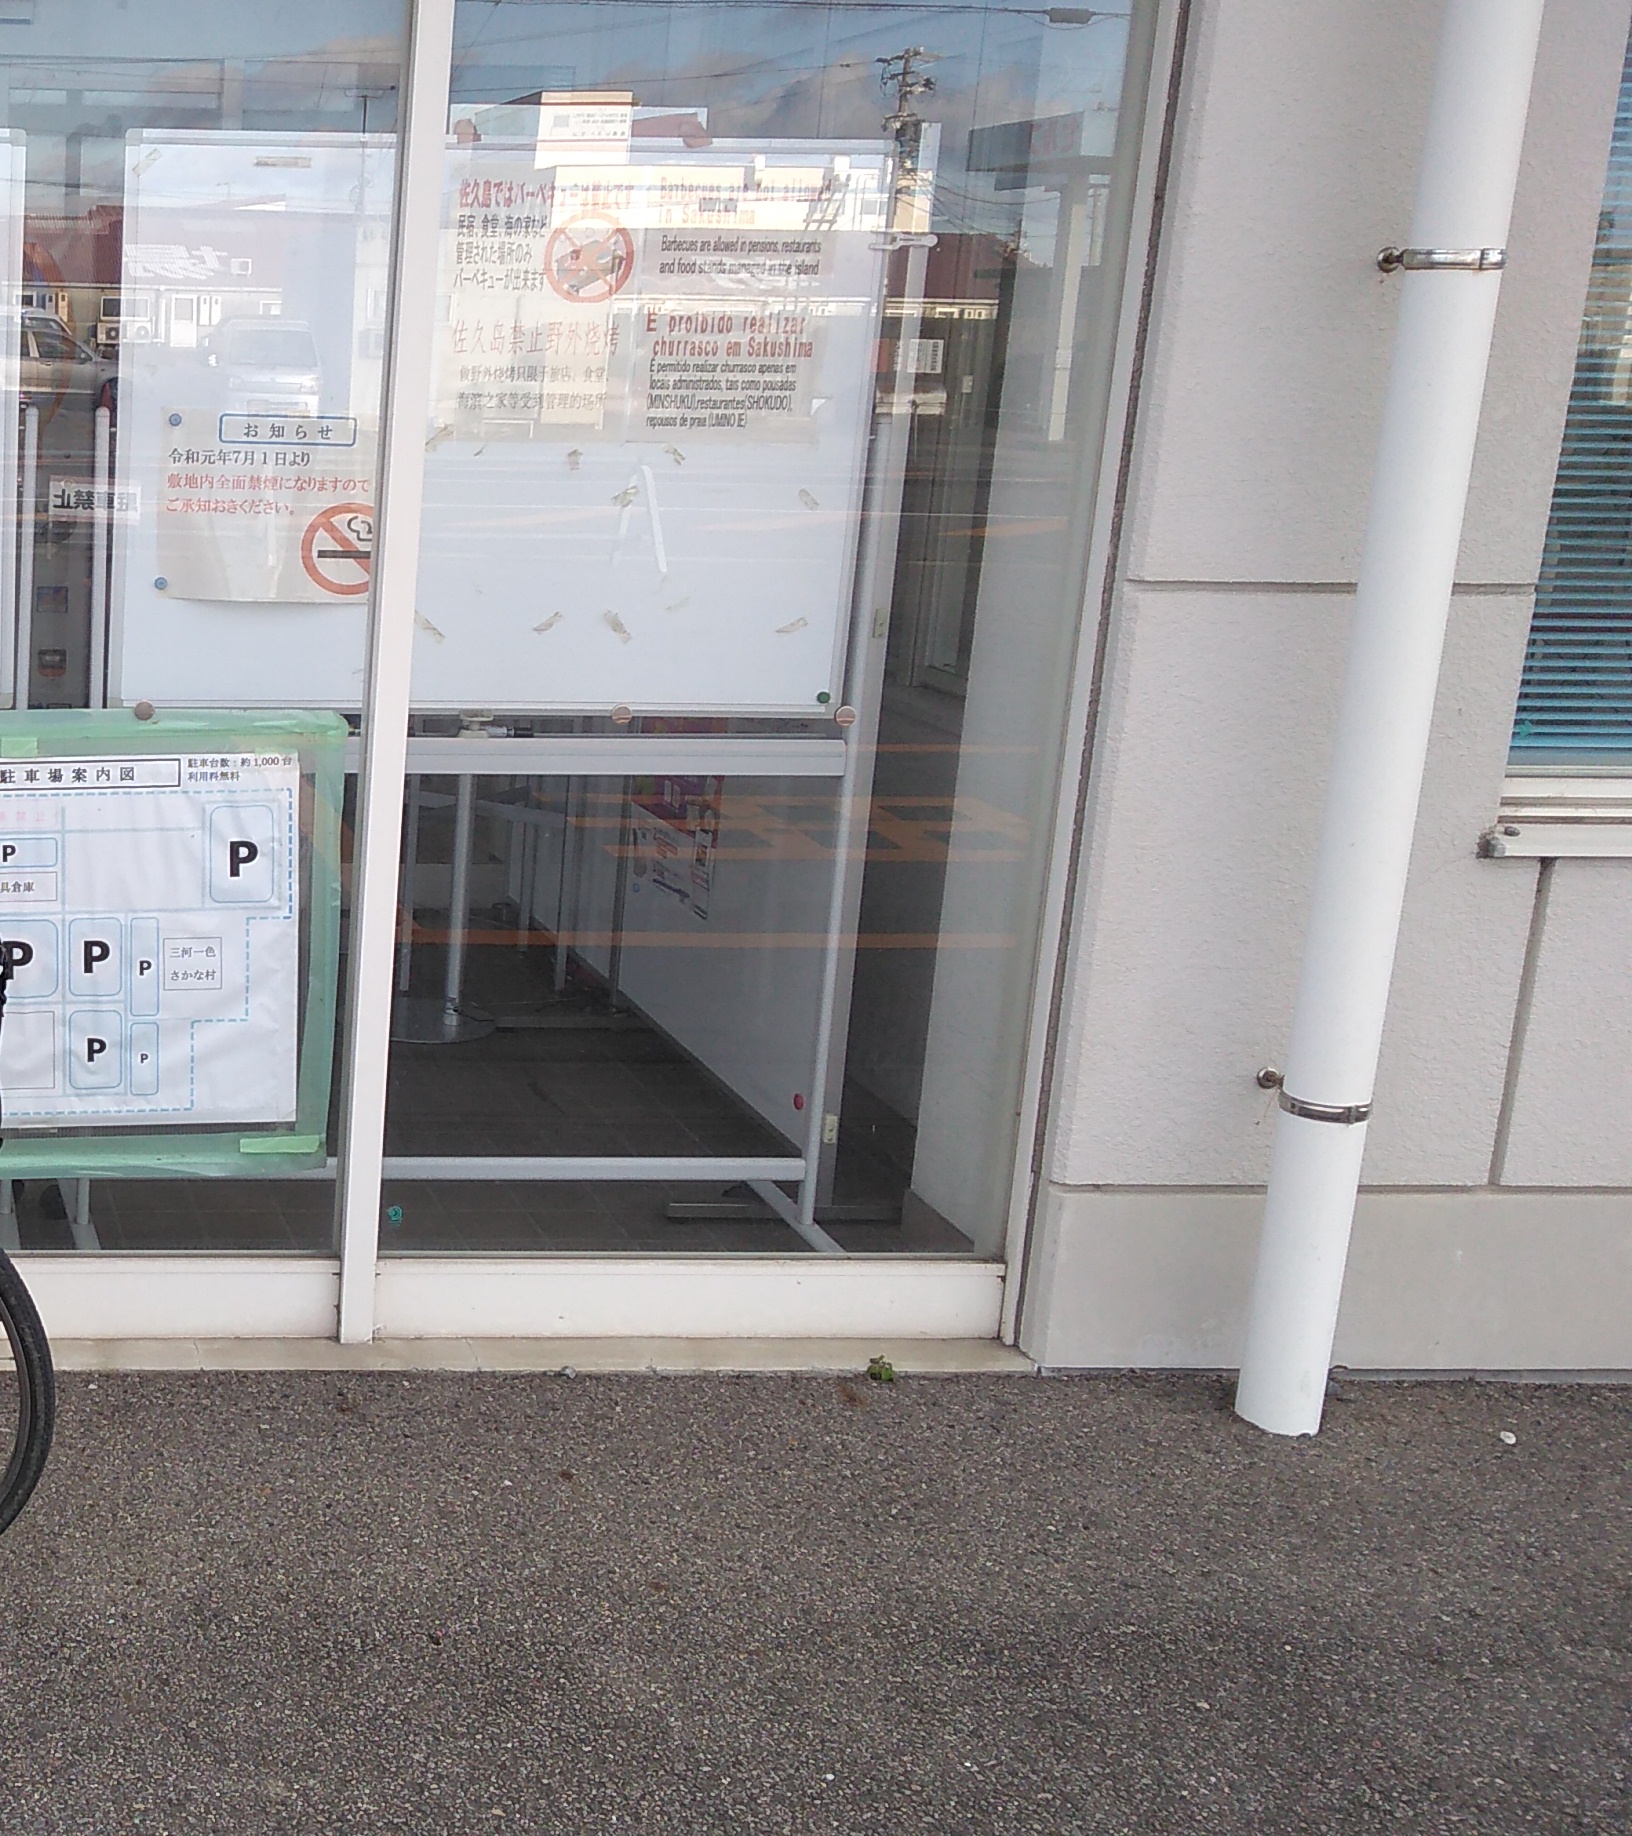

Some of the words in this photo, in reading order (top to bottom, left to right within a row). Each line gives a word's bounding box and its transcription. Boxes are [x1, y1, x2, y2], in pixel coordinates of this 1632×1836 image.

[660, 177, 722, 200] Barbecues
[659, 205, 672, 224] in
[456, 241, 533, 265] 管理された場所のみ
[661, 235, 698, 252] Barbecues
[699, 238, 711, 252] are
[713, 236, 739, 252] allowed
[739, 237, 747, 252] in
[748, 239, 779, 255] pensions,
[781, 239, 821, 253] restaurants
[659, 259, 675, 274] and
[678, 257, 696, 274] food
[699, 259, 727, 274] stands
[794, 259, 819, 275] island
[453, 268, 546, 291] バーベキューが出来ます
[669, 314, 733, 335] proibido
[742, 312, 805, 334] realizar
[653, 335, 718, 358] churrasco
[726, 341, 741, 357] em
[747, 337, 813, 358] Sakushima
[657, 360, 690, 374] permitido
[692, 359, 719, 372] realizar
[721, 360, 757, 373] churrasco
[758, 362, 783, 375] apenas
[785, 364, 796, 373] em
[649, 376, 670, 390] locais
[672, 377, 723, 392] administrados,
[725, 377, 739, 391] tais
[741, 381, 761, 391] como
[762, 379, 796, 393] pousadas
[646, 415, 678, 429] repousos
[679, 414, 689, 427] de
[244, 423, 333, 440] お知らせ
[168, 448, 310, 467] 令和元年7月1日より
[167, 473, 369, 493] 敷地内全面禁煙になりますので
[166, 499, 296, 516] ご承知おきください。
[0, 766, 135, 784] 駐車場案内図
[187, 771, 241, 783] 利用料無料
[2, 845, 16, 862] P
[228, 840, 258, 878] P
[3, 941, 34, 980] P
[83, 940, 110, 974] P
[170, 946, 217, 958] 三河一色
[139, 960, 152, 976] P
[170, 969, 217, 982] さかな村
[87, 1038, 107, 1062] P
[140, 1053, 149, 1064] P
